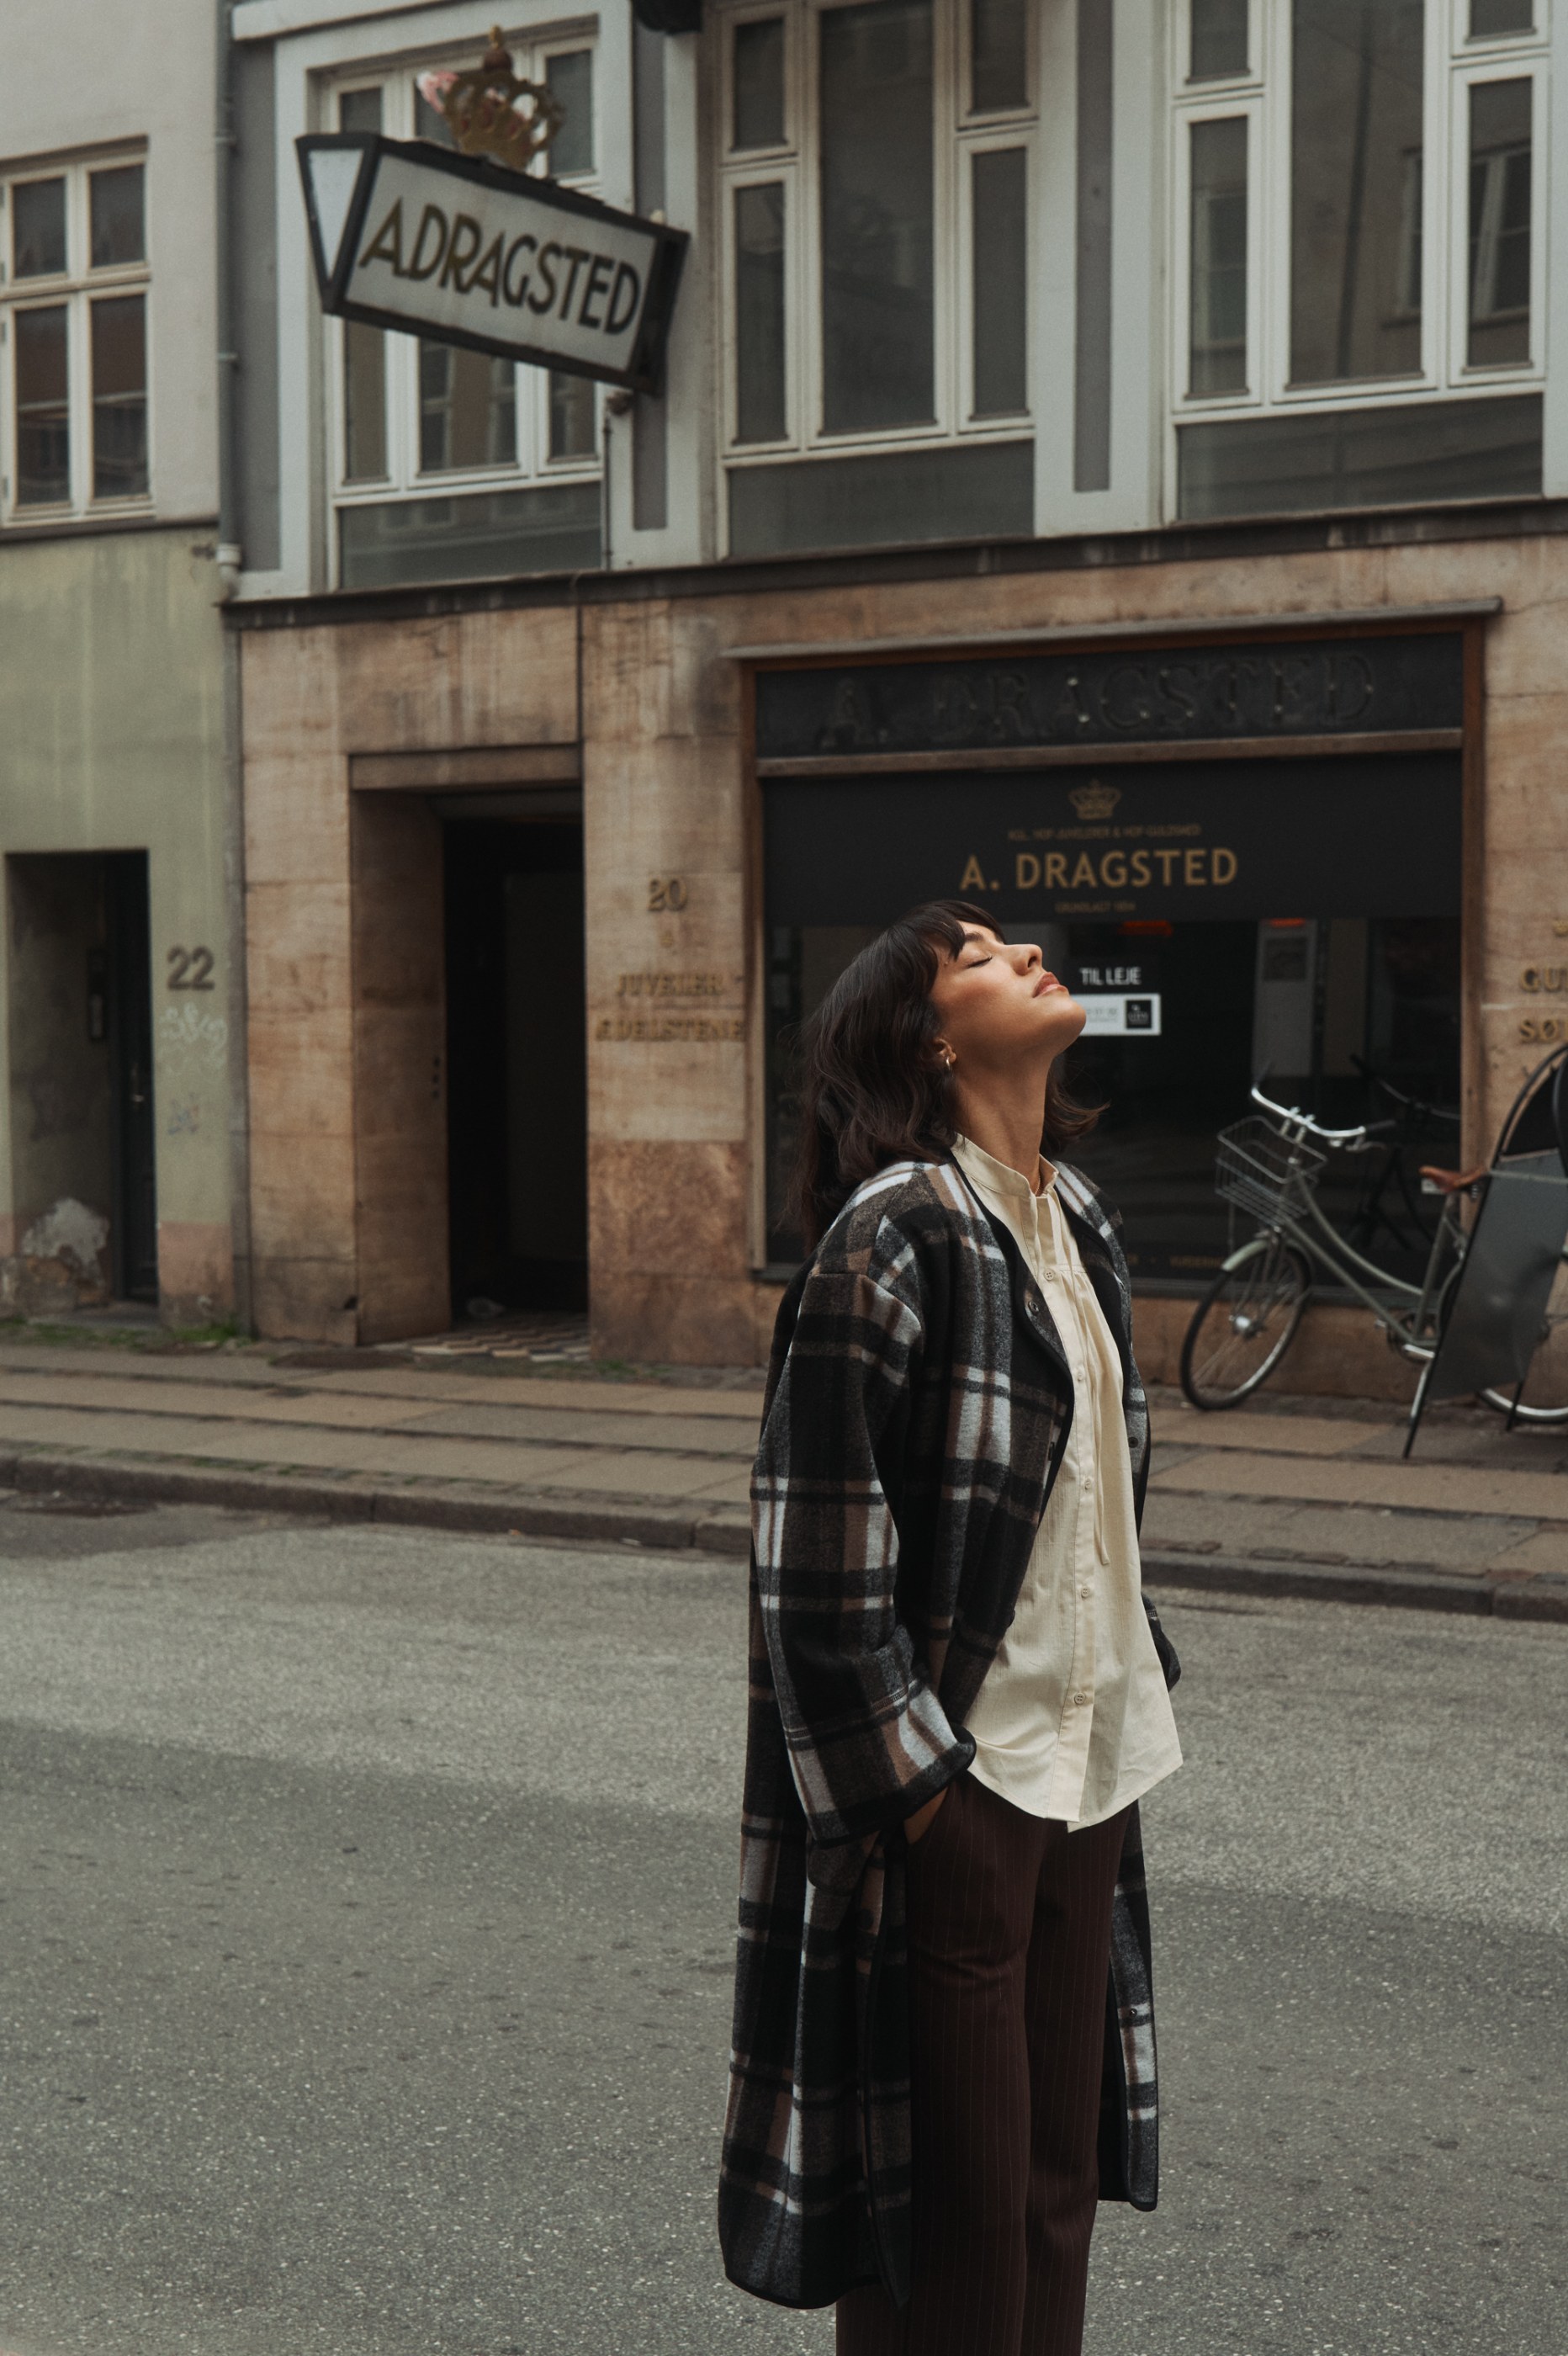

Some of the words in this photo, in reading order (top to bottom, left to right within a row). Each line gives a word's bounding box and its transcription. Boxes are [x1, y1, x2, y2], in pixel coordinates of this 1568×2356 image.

[935, 654, 1375, 740] DRAGSTED
[960, 854, 1000, 890] A.
[1016, 848, 1237, 889] DRAGSTED
[648, 878, 688, 911] 20
[167, 946, 215, 990] 22
[1079, 967, 1104, 985] TIL
[1105, 967, 1142, 985] LEJE
[1519, 968, 1568, 993] GU
